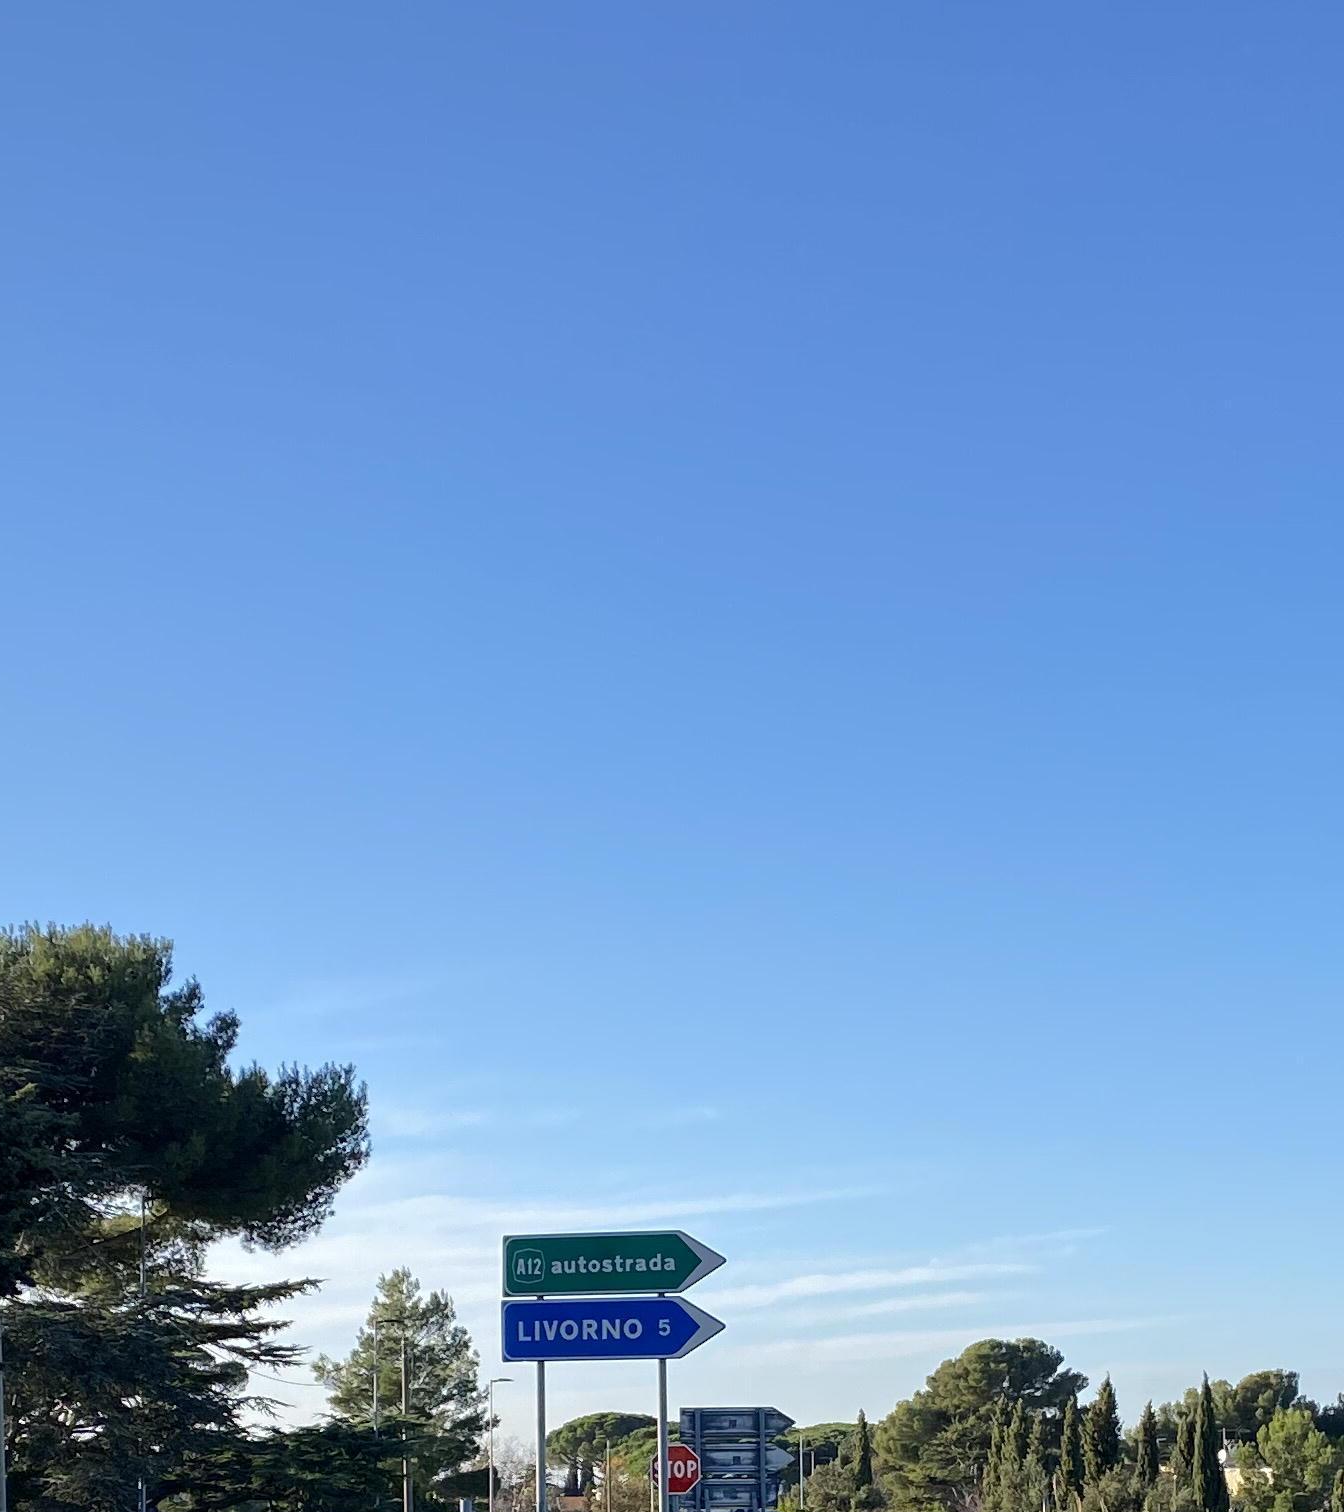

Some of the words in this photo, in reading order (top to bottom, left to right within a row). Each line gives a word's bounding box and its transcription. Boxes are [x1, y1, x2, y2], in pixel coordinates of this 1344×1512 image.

[516, 1257, 542, 1275] A12
[551, 1253, 676, 1274] autostrada
[518, 1318, 643, 1342] LIVORNO
[658, 1318, 671, 1337] 5
